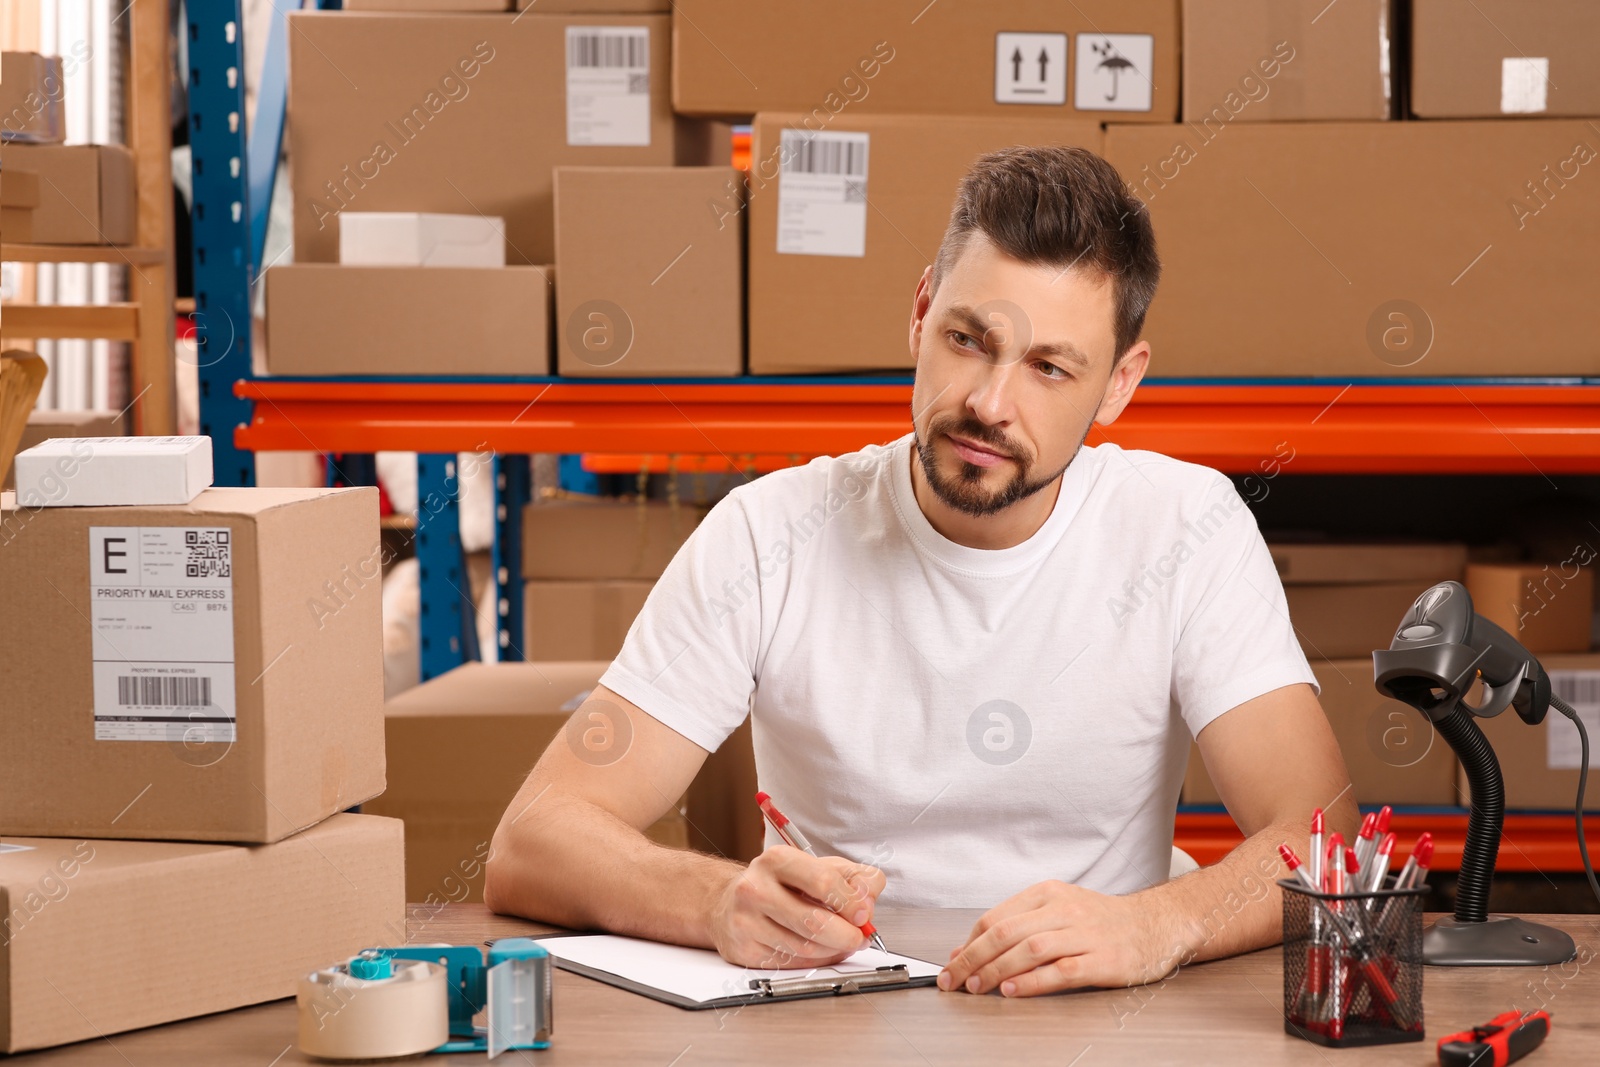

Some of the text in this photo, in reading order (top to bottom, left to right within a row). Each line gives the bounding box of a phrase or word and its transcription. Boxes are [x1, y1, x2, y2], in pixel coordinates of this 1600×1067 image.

[104, 538, 127, 573] E
[97, 588, 226, 599] PRIORITY MAIL EXPRESS
[173, 602, 196, 612] C463
